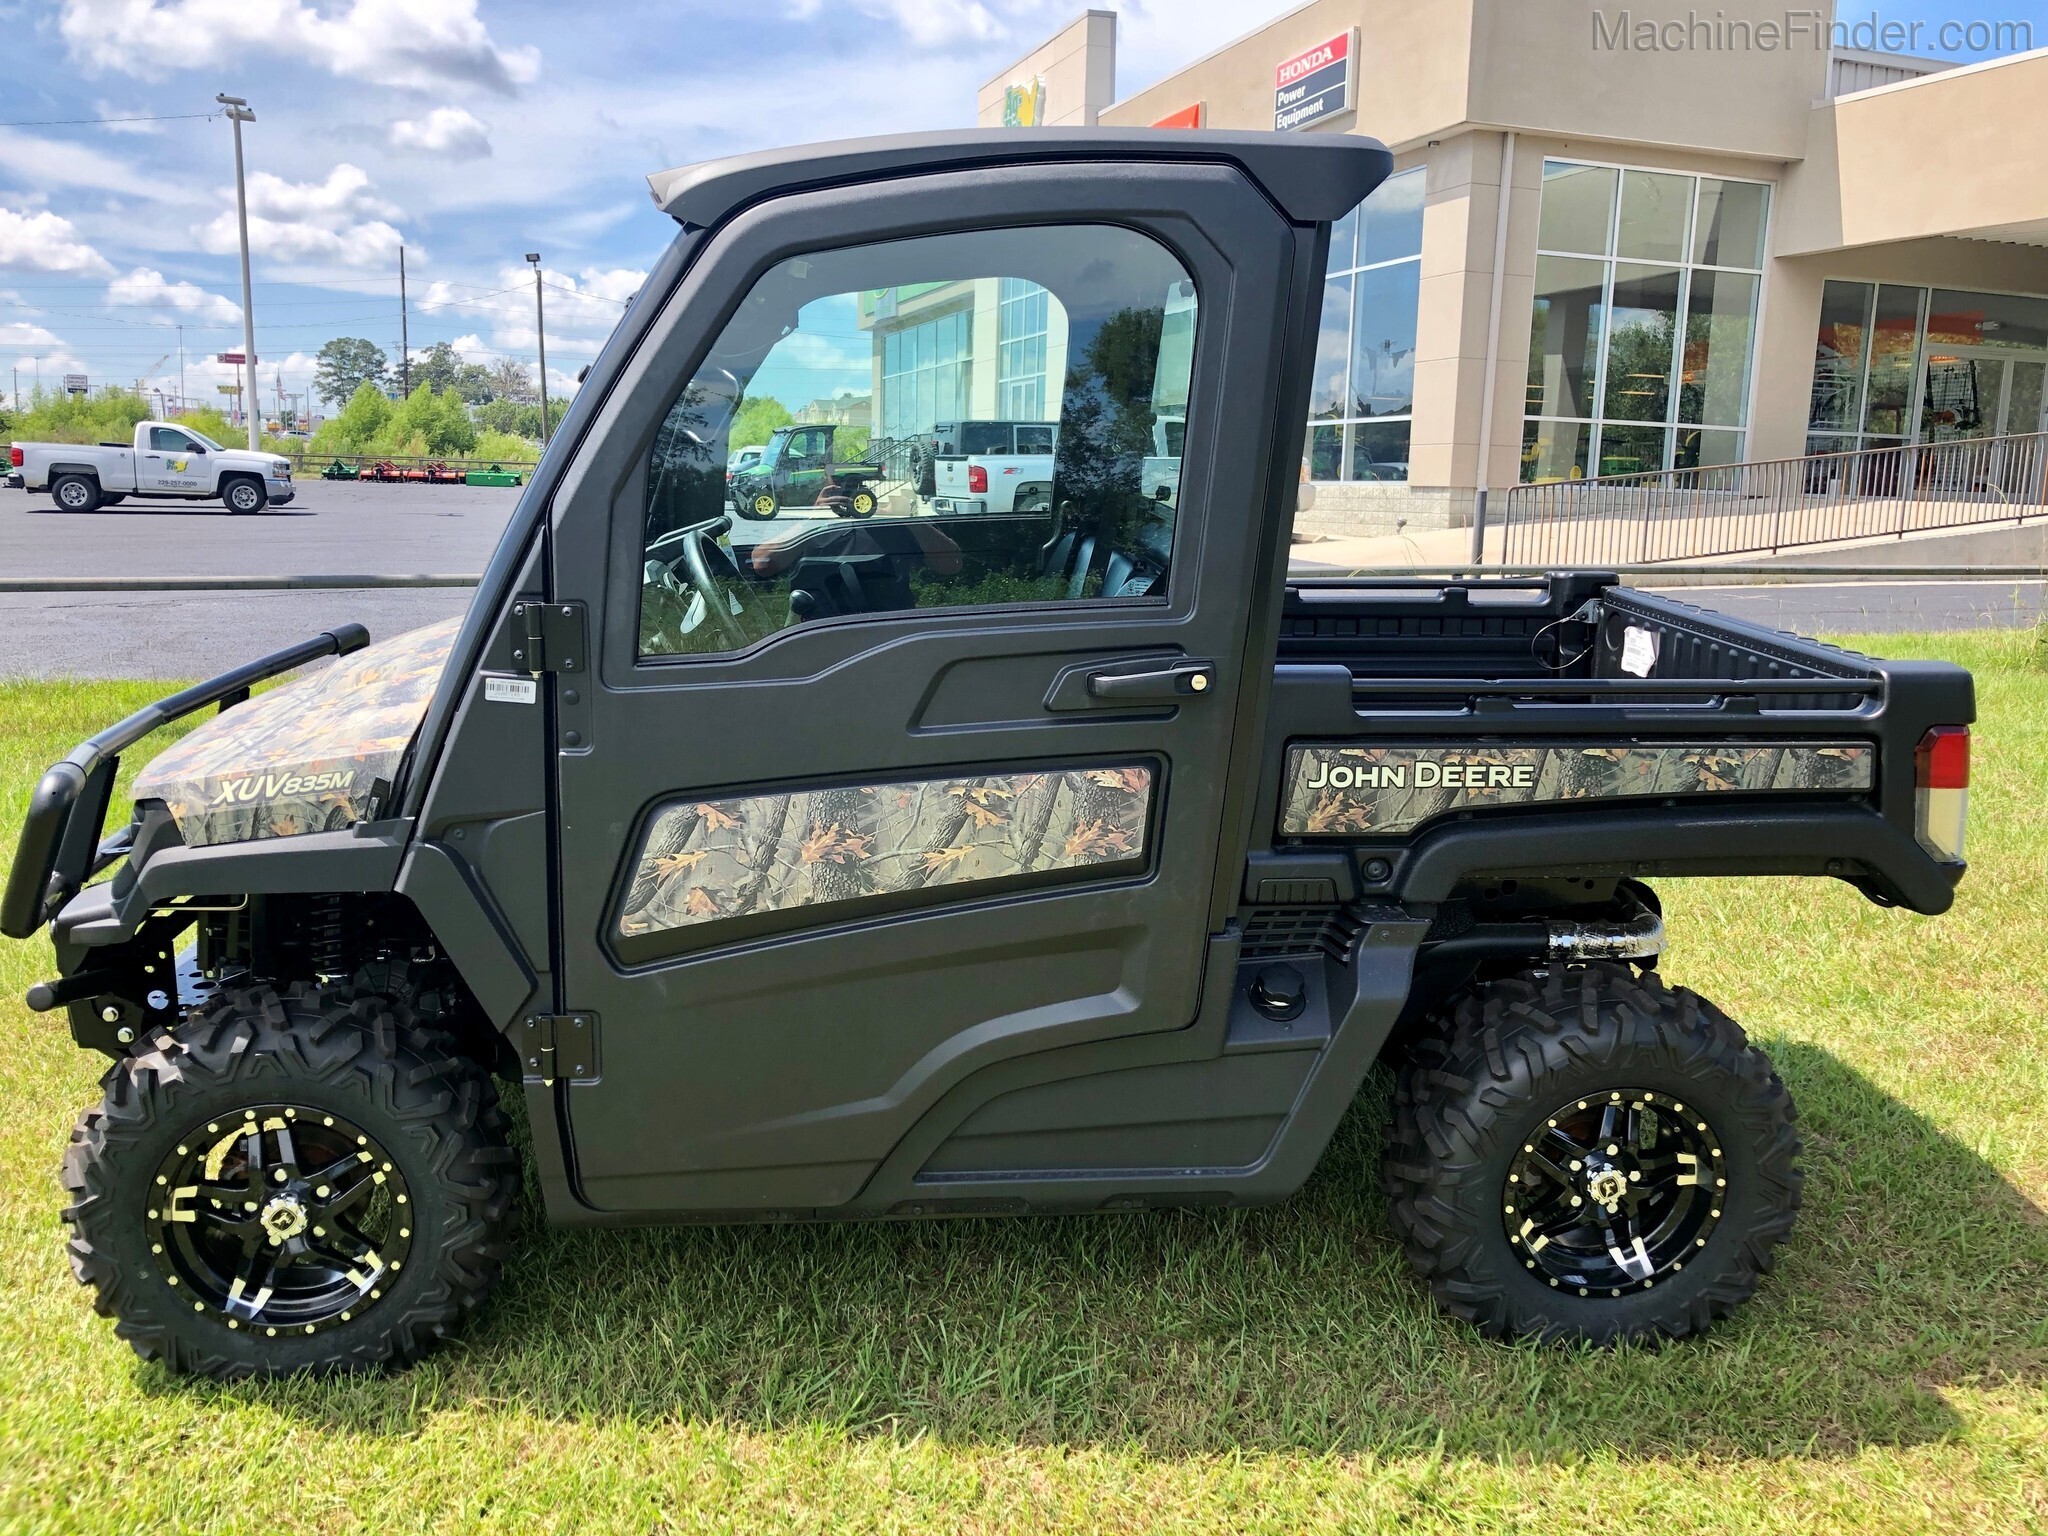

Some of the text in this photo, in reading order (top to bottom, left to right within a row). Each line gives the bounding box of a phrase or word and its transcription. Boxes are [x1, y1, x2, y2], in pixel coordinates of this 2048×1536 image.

[1279, 46, 1334, 83] HONDA
[1277, 85, 1306, 107] Power
[1276, 98, 1324, 129] Equipment
[208, 769, 356, 808] XUV835M
[1308, 761, 1534, 788] JOHN DEERE
